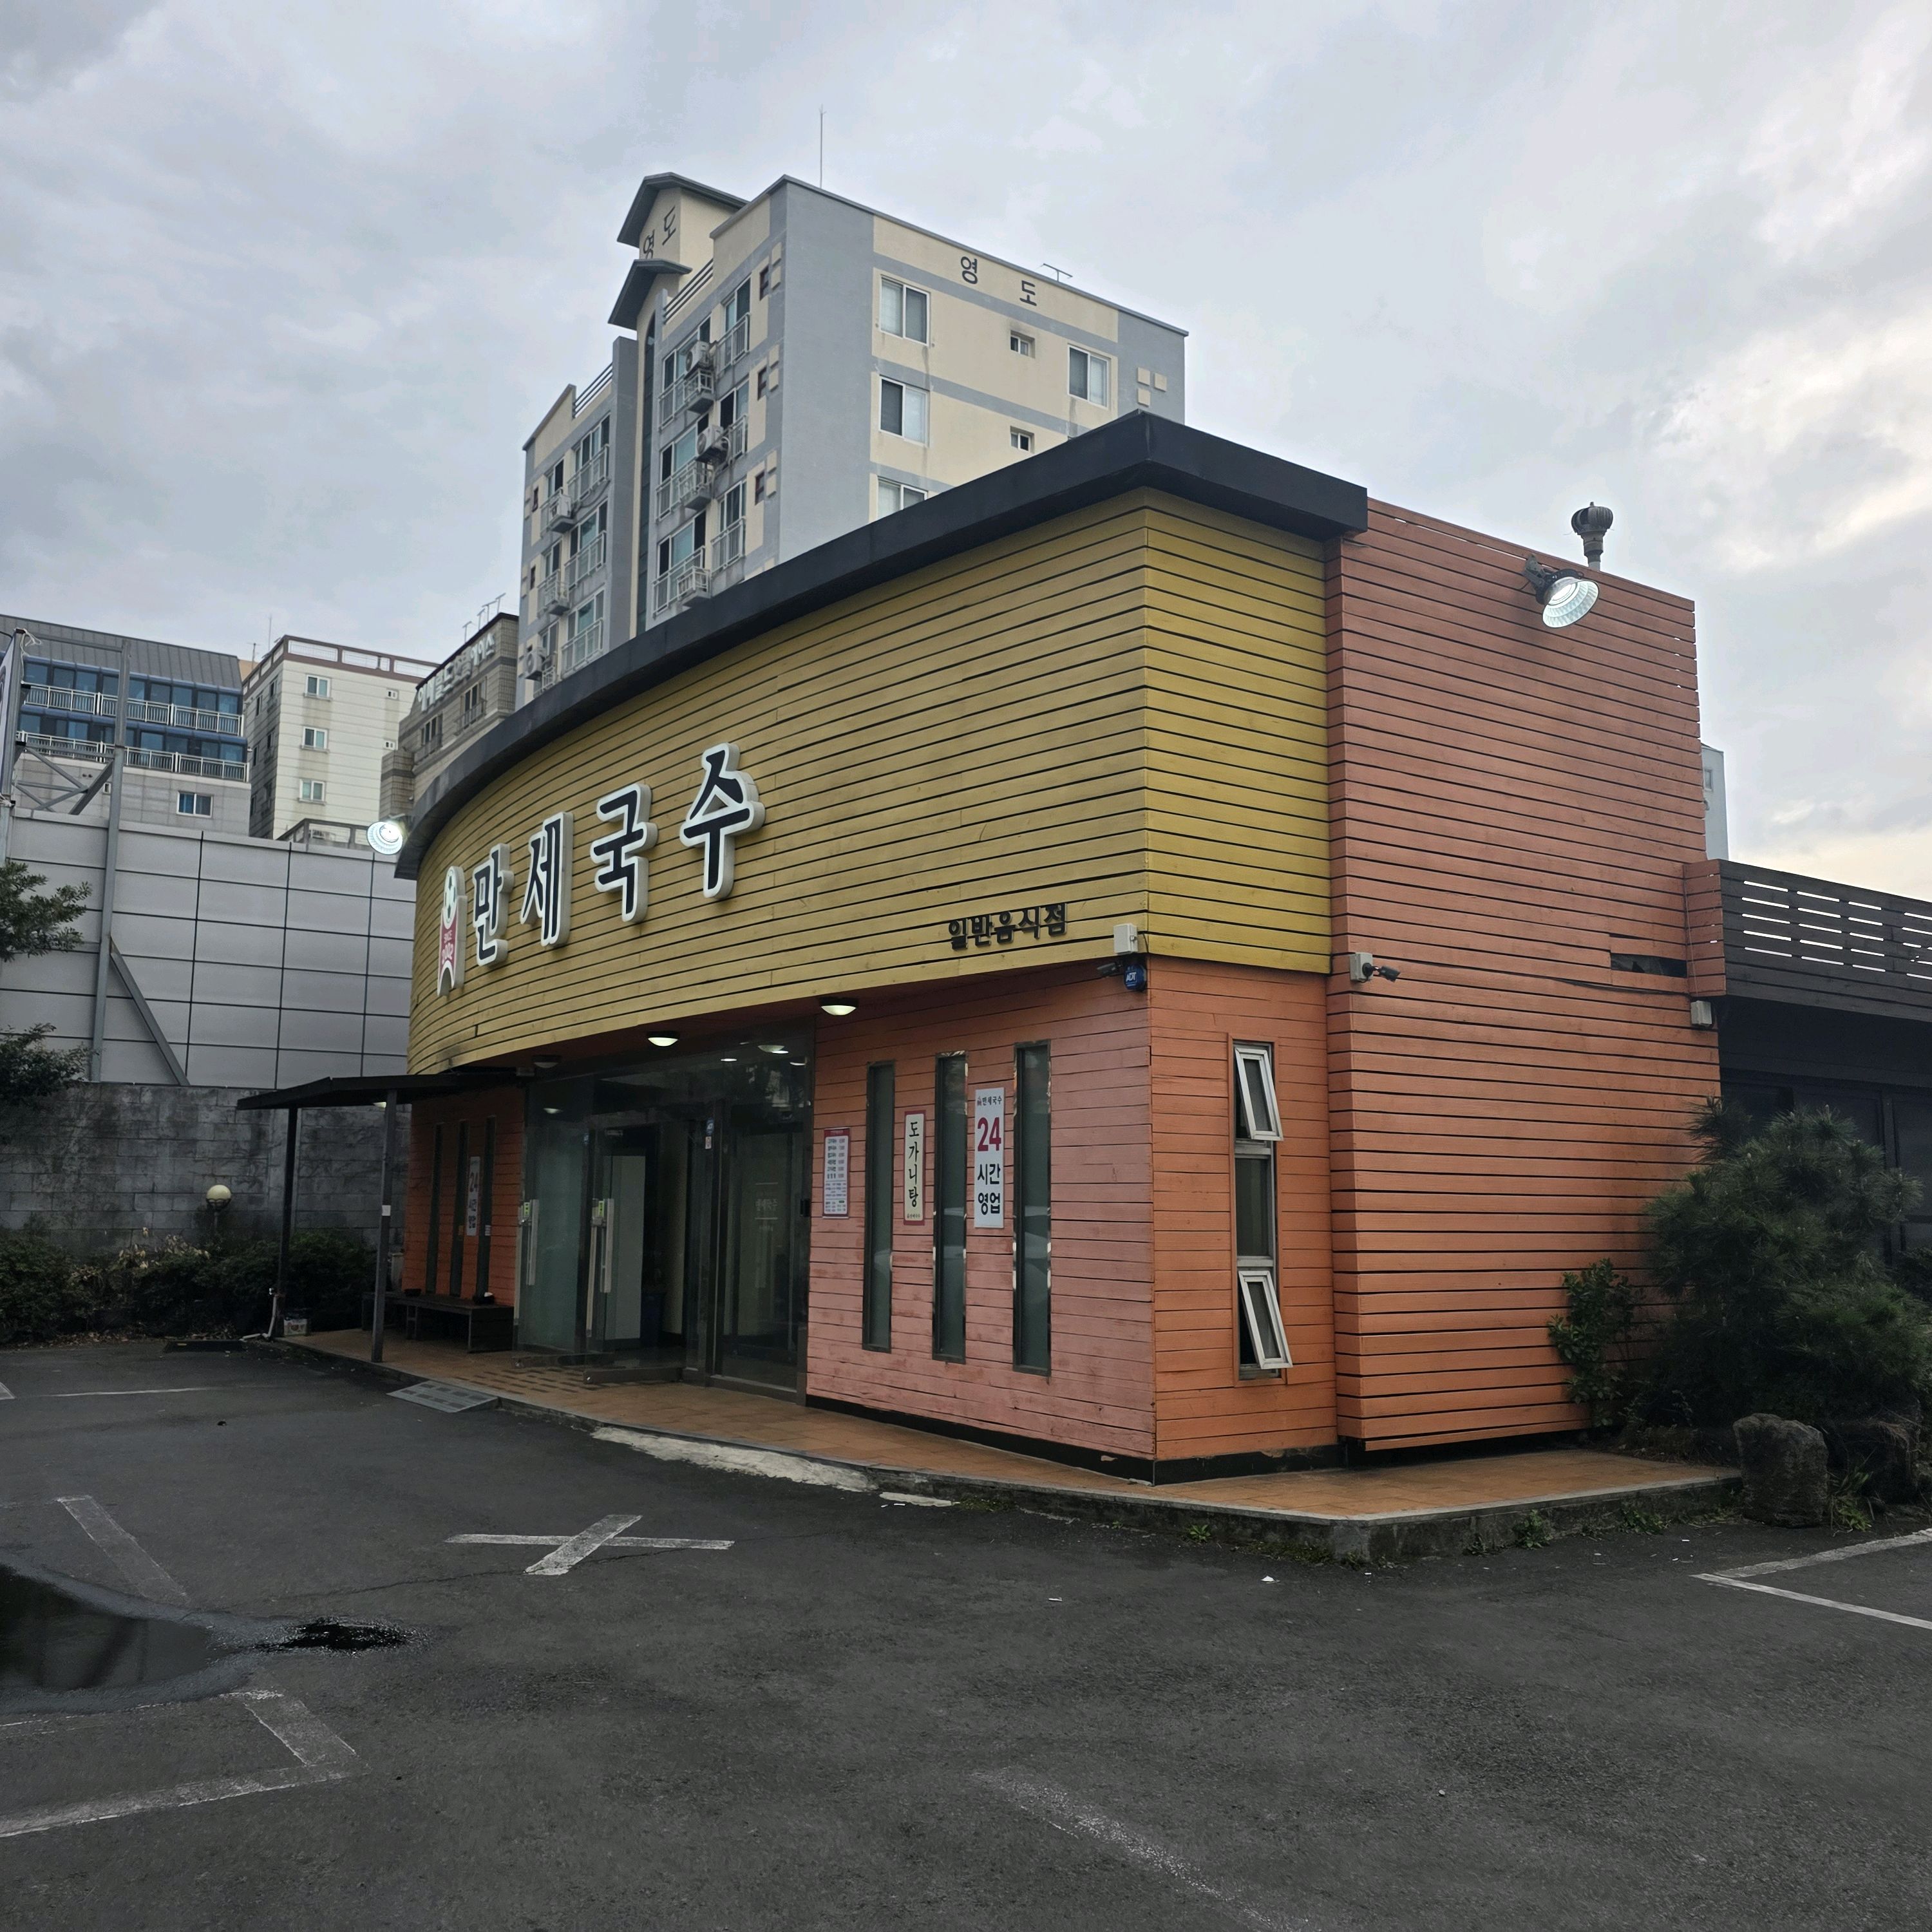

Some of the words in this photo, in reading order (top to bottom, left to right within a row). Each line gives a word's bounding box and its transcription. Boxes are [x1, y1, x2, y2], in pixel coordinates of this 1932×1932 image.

[961, 256, 1037, 307] 영도
[473, 743, 765, 965] 만세국수
[948, 903, 1067, 950] 일반음식점
[1126, 972, 1137, 982] ADT
[982, 1095, 1002, 1106] 만세국수
[977, 1117, 1001, 1151] 24
[909, 1121, 920, 1208] 도가니탕
[978, 1164, 1001, 1185] 시간
[978, 1192, 1001, 1216] 영업
